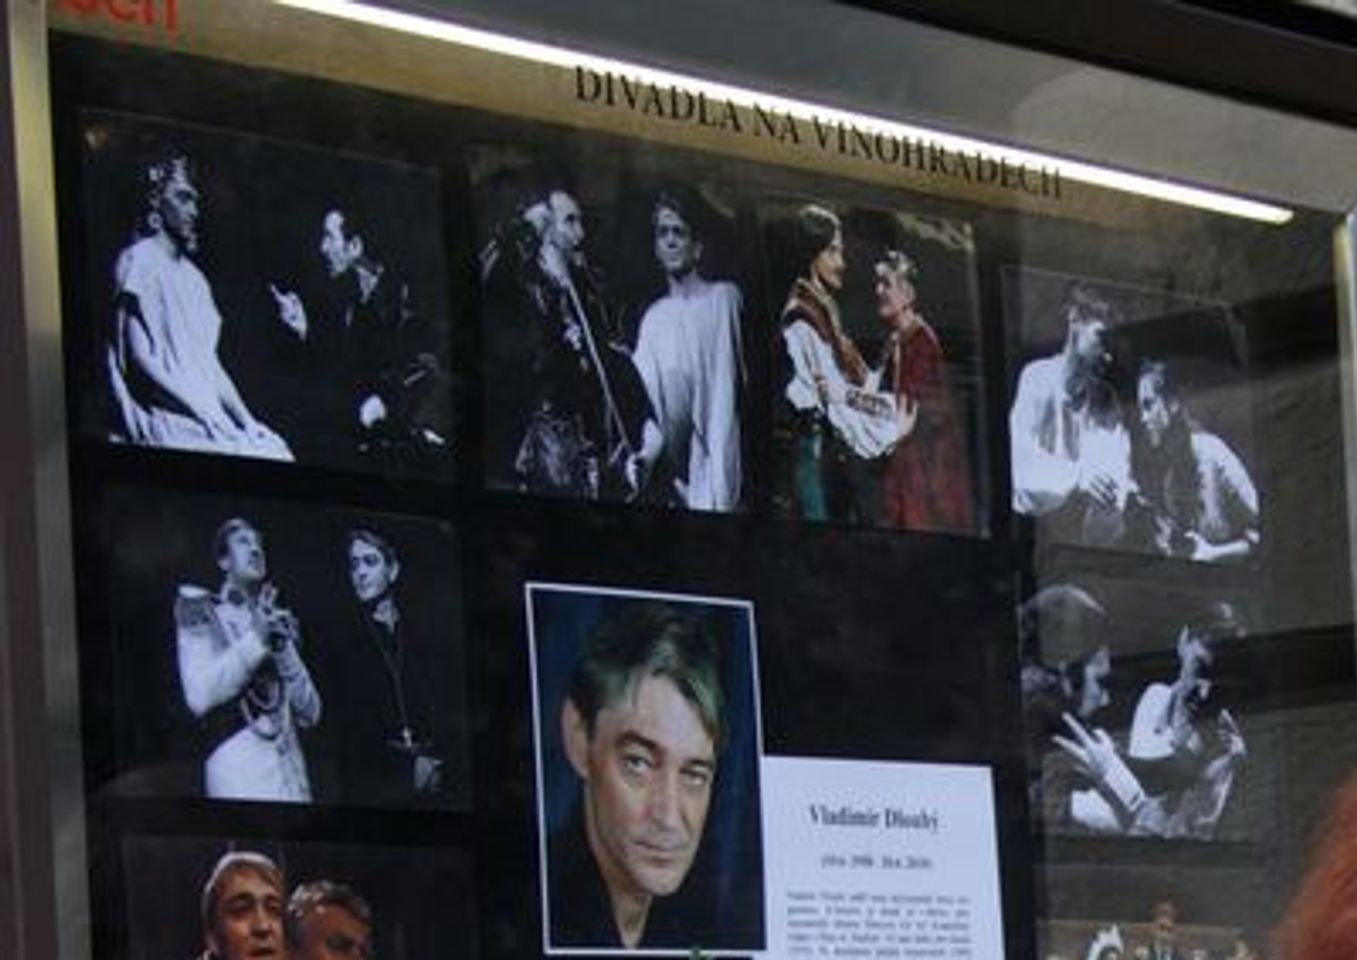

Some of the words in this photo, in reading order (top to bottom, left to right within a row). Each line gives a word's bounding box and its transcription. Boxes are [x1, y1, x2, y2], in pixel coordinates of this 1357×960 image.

[575, 65, 741, 133] DIVADLA
[752, 101, 800, 144] NA
[811, 114, 1061, 199] VINOHRADECH
